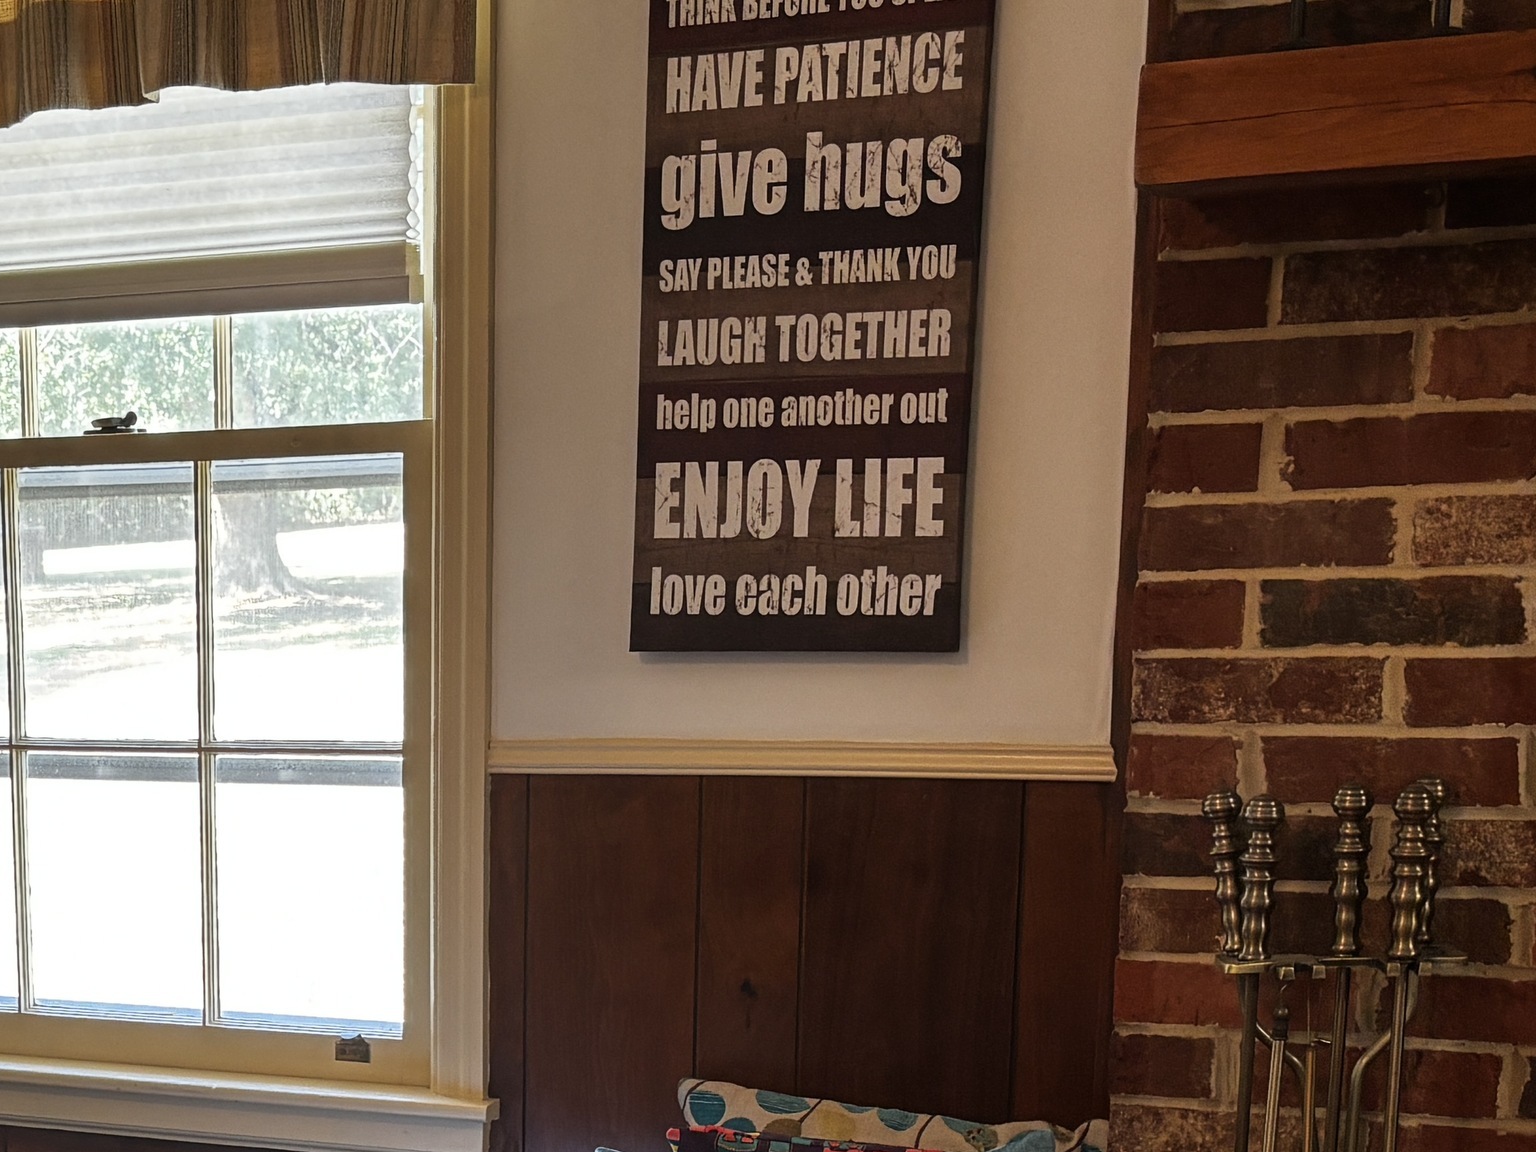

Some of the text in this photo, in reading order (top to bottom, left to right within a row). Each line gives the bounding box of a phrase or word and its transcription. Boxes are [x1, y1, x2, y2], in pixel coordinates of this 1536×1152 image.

[666, 0, 737, 29] THINK
[666, 30, 965, 114] HAVE PATIENCE
[661, 131, 962, 231] give hugs
[659, 244, 957, 292] SAY PLEASE & THANK YOU
[657, 308, 952, 366] LAUGH TOGETHER
[657, 388, 949, 433] help one another out
[654, 457, 945, 539] ENJOY LIFE
[650, 566, 942, 616] love each other
